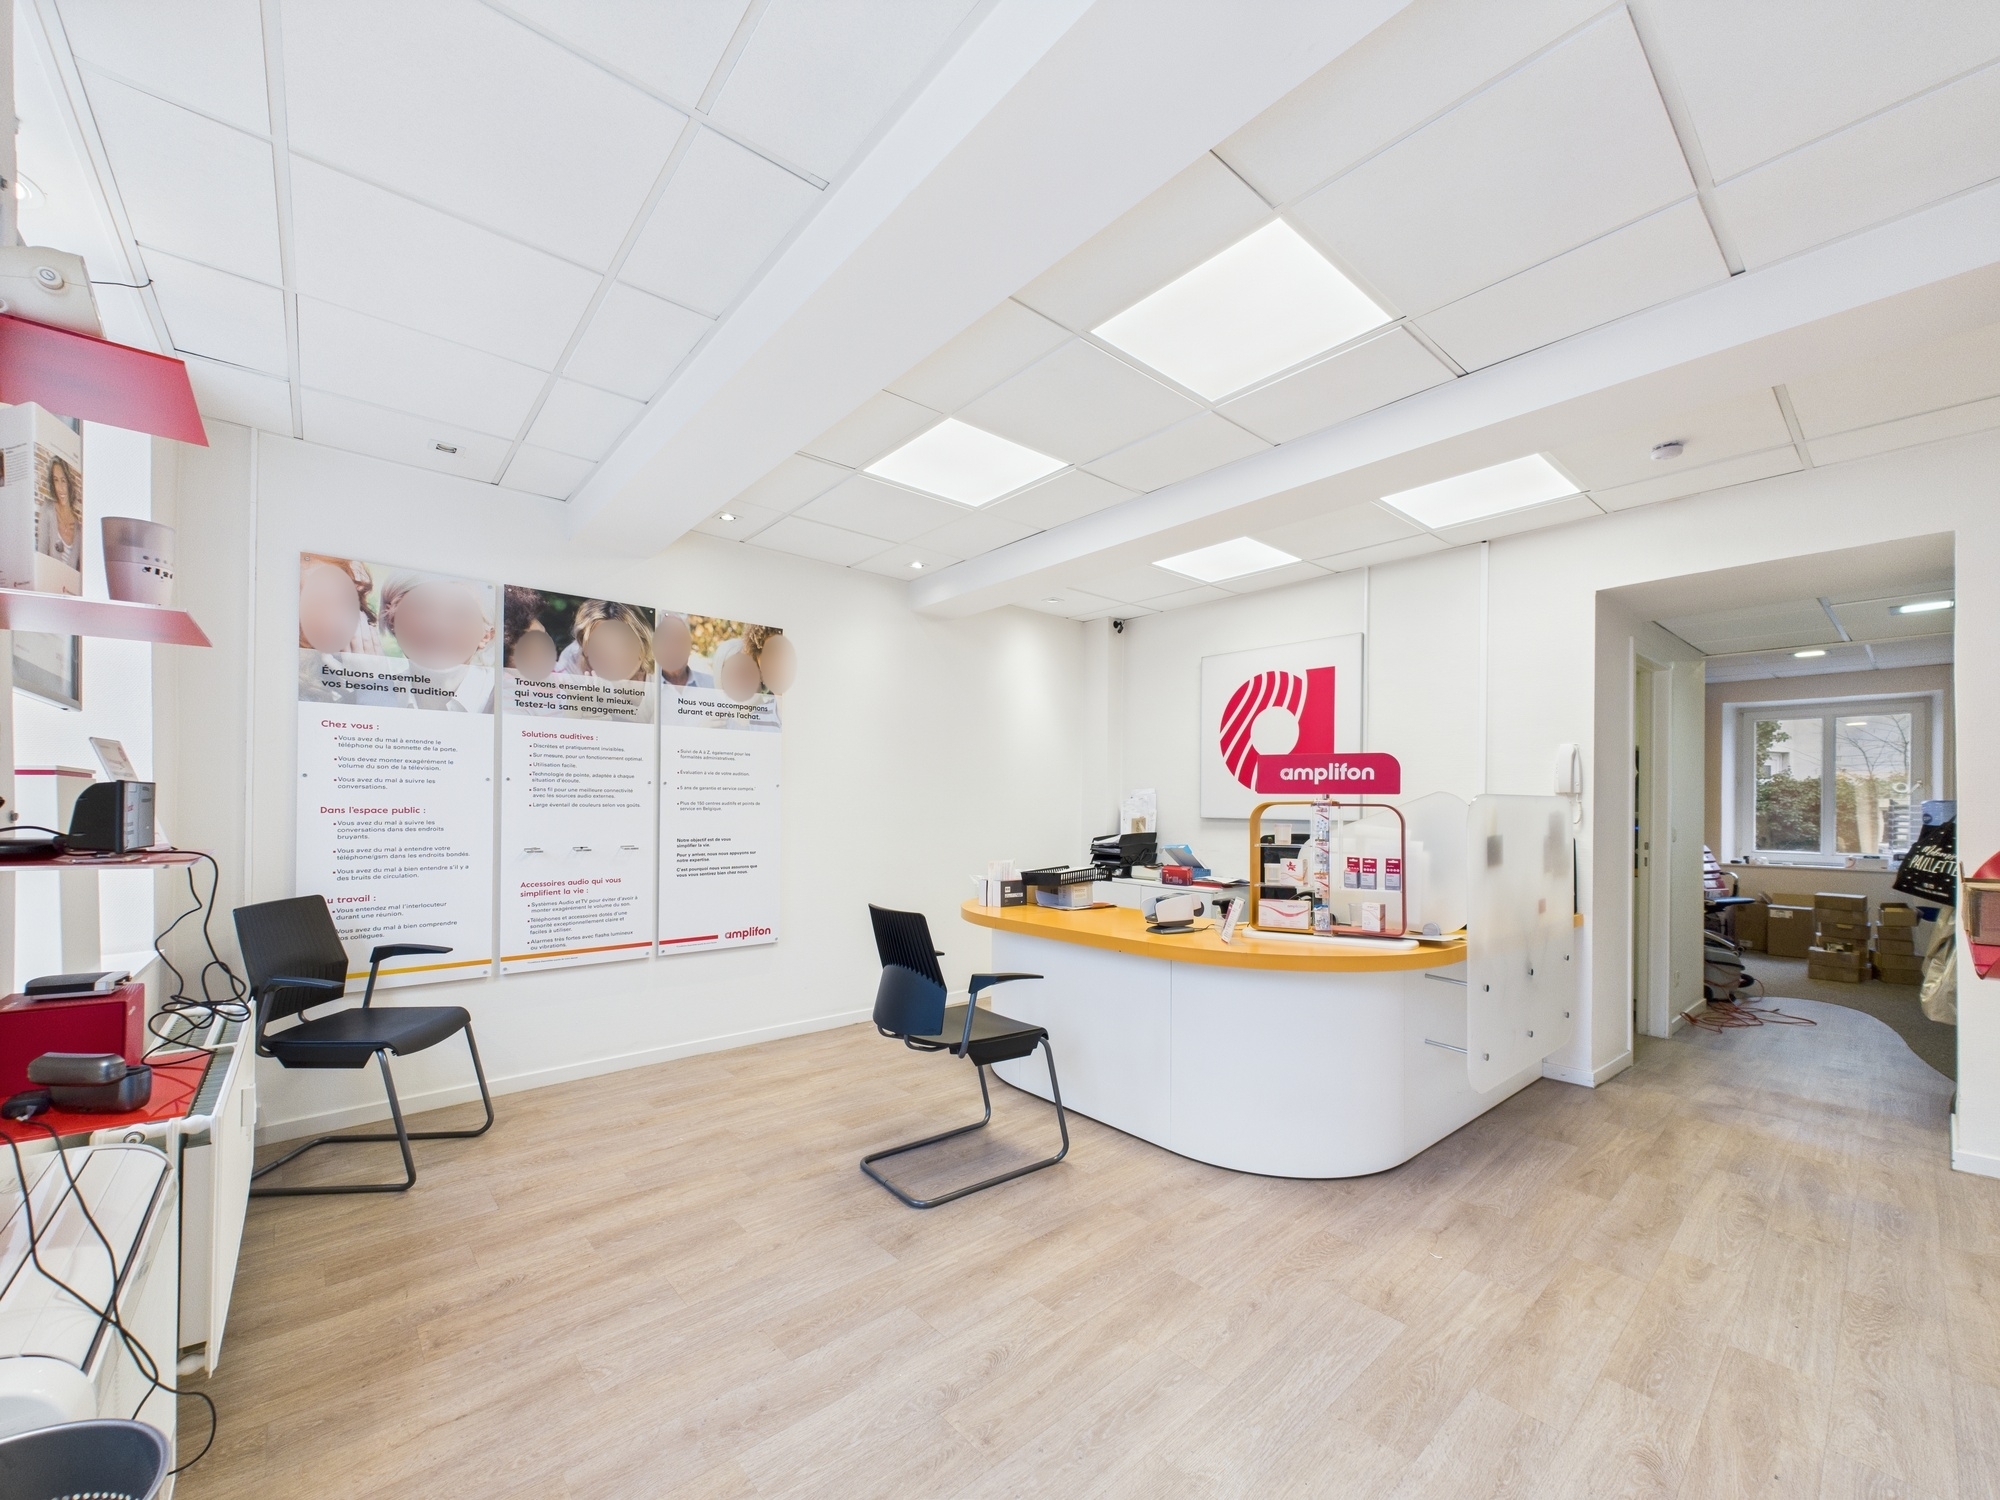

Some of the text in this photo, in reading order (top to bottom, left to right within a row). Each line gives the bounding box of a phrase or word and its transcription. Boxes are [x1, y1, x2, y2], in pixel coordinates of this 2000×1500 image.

[321, 665, 431, 684] Évaluons ensemble
[345, 680, 389, 692] besoins
[410, 686, 457, 697] audition.
[515, 678, 645, 696] Trouvons ensemble la solution
[514, 689, 530, 698] qui
[556, 693, 594, 702] convient
[596, 694, 604, 703] le
[606, 696, 633, 705] mieux.
[515, 699, 556, 709] Testez-la
[678, 698, 697, 706] Nous
[716, 703, 768, 712] accompagnons
[678, 707, 703, 716] durant
[715, 711, 735, 719] après
[736, 711, 760, 720] l'achat.
[321, 720, 347, 729] Chez
[522, 730, 594, 740] Solutions auditives
[1280, 763, 1374, 784] amplifon
[348, 806, 388, 815] l'espace
[391, 806, 420, 815] public
[520, 879, 566, 888] Accessoires
[567, 878, 590, 886] audio
[591, 877, 603, 886] qui
[337, 894, 370, 903] travail
[520, 888, 561, 898] simplifient
[725, 926, 771, 940] amplifon
